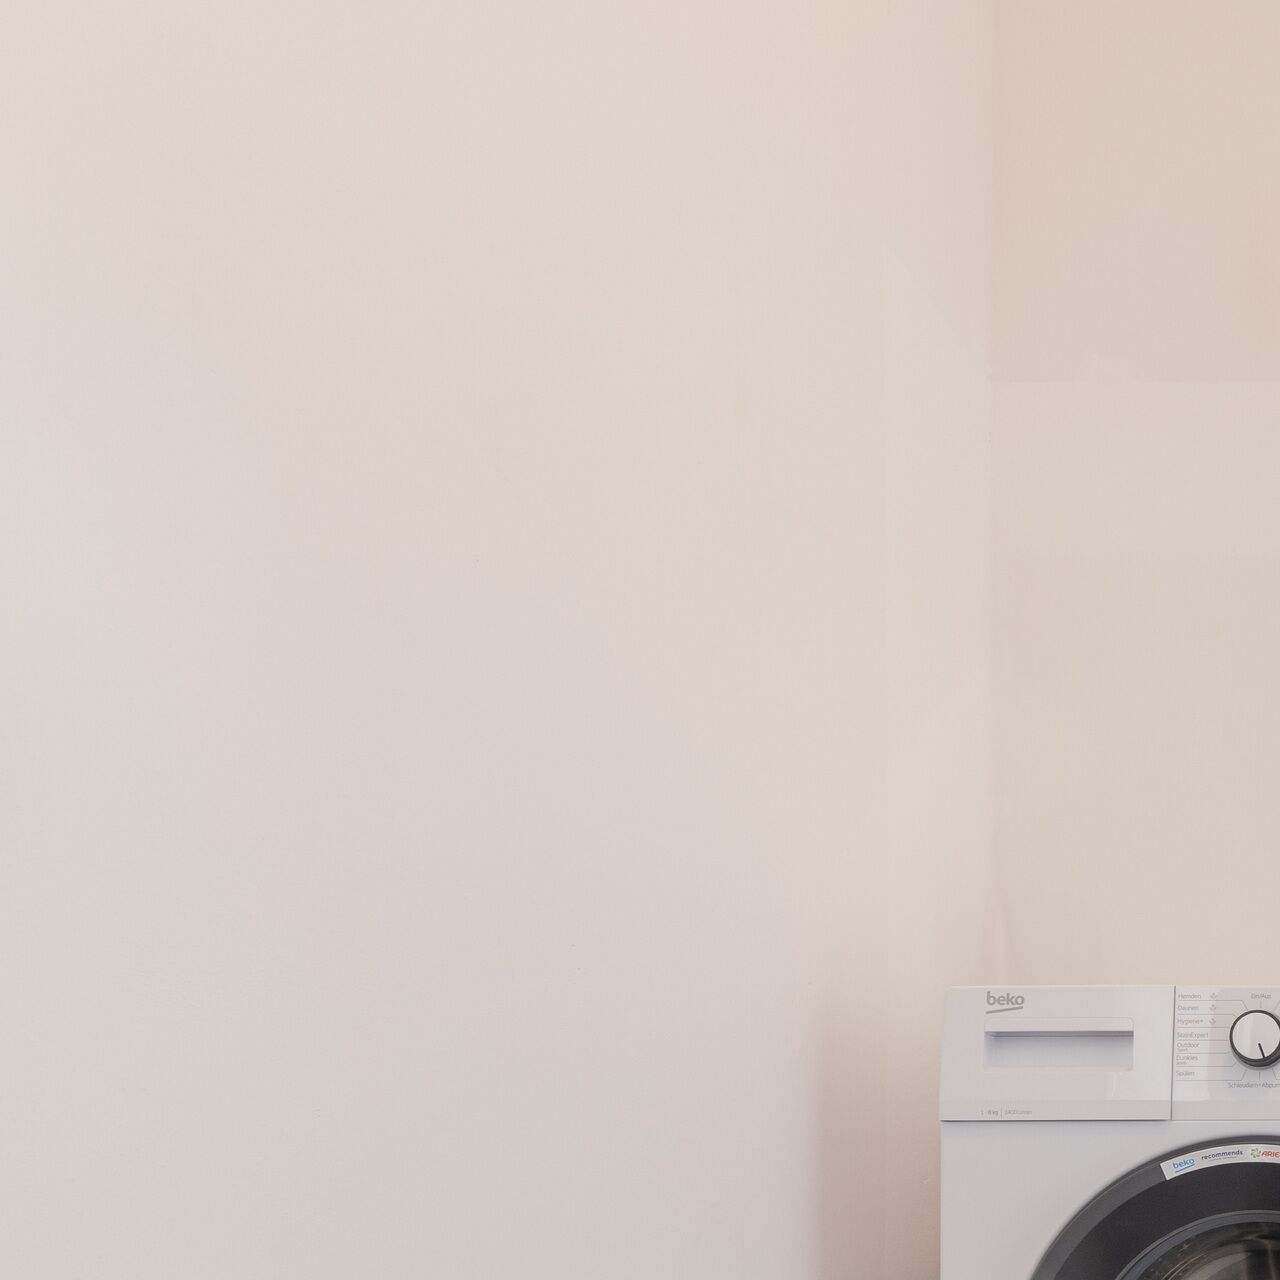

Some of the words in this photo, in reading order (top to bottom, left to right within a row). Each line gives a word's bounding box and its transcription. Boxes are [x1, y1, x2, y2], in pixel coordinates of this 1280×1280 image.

[986, 991, 1025, 1008] beko
[1172, 1158, 1195, 1170] beko
[1201, 1150, 1243, 1160] recommends
